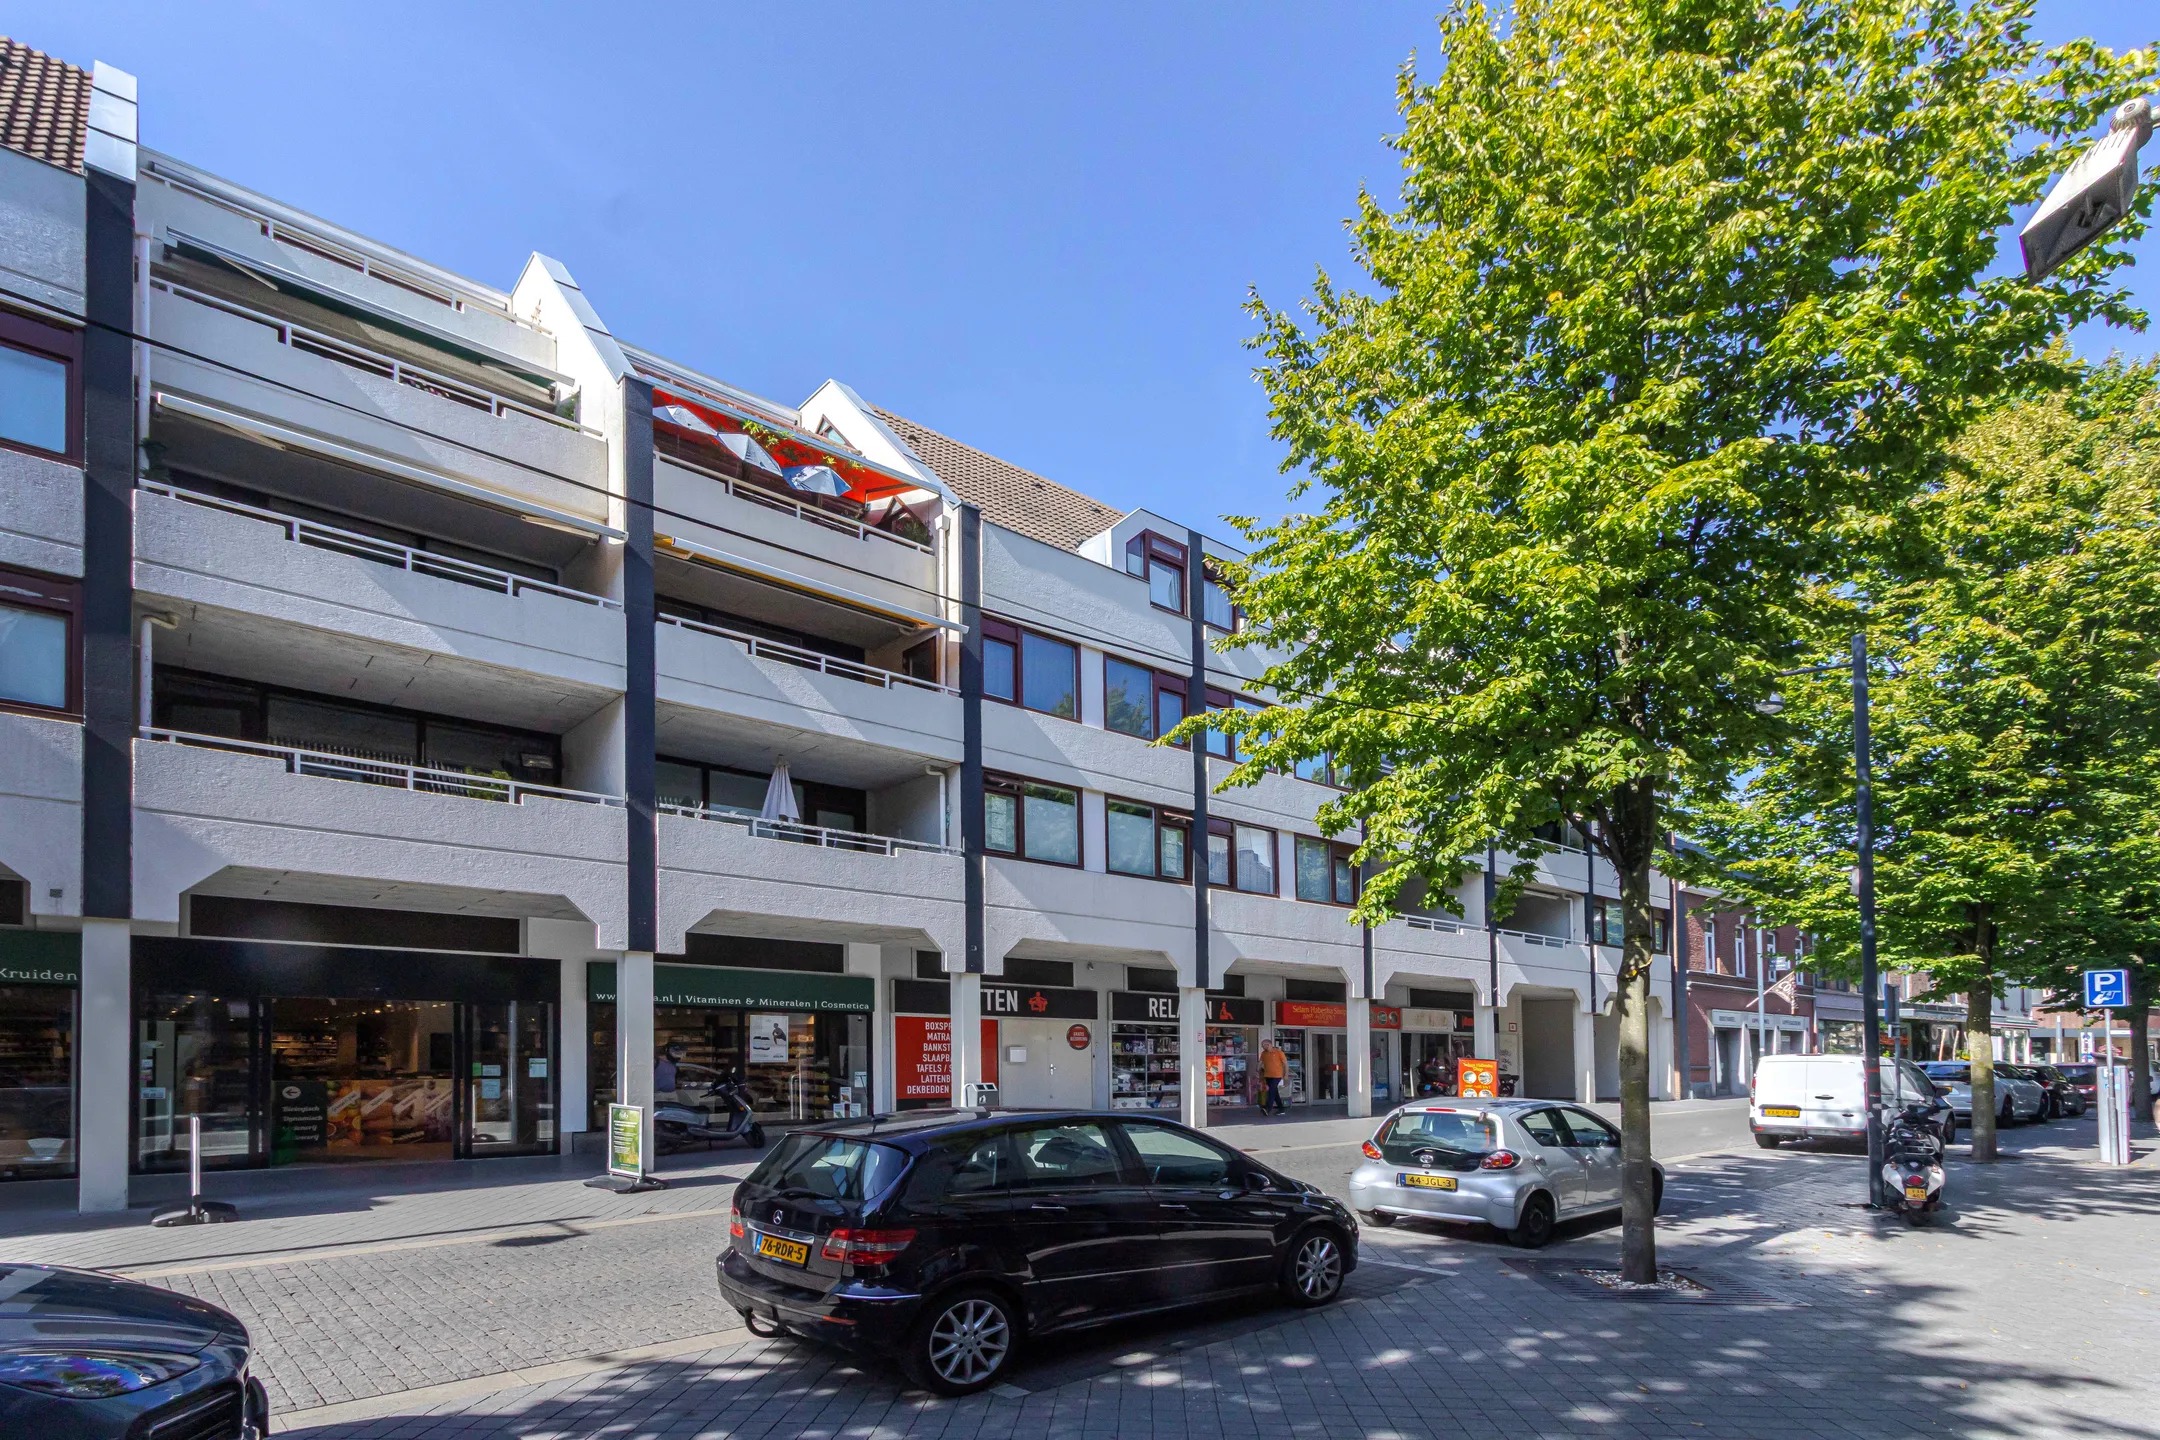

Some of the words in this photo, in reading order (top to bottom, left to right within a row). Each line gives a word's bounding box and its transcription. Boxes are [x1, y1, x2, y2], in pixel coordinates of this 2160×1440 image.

[0, 968, 77, 981] Kruiden
[2094, 973, 2117, 992] P
[685, 995, 741, 1005] Vitaminen
[759, 998, 811, 1008] Mineralen
[821, 1001, 869, 1010] Cosmetica
[1292, 1005, 1309, 1013] Selam
[927, 1033, 951, 1041] MATRA
[923, 1043, 951, 1052] BANKST
[922, 1054, 951, 1062] SLAAPB
[916, 1064, 942, 1073] TAFELS
[920, 1074, 951, 1083] LATTENB
[907, 1085, 950, 1095] DEKBEDDEN
[1409, 1176, 1451, 1188] 44-JGL-3
[762, 1238, 803, 1261] 76-RDR-5
